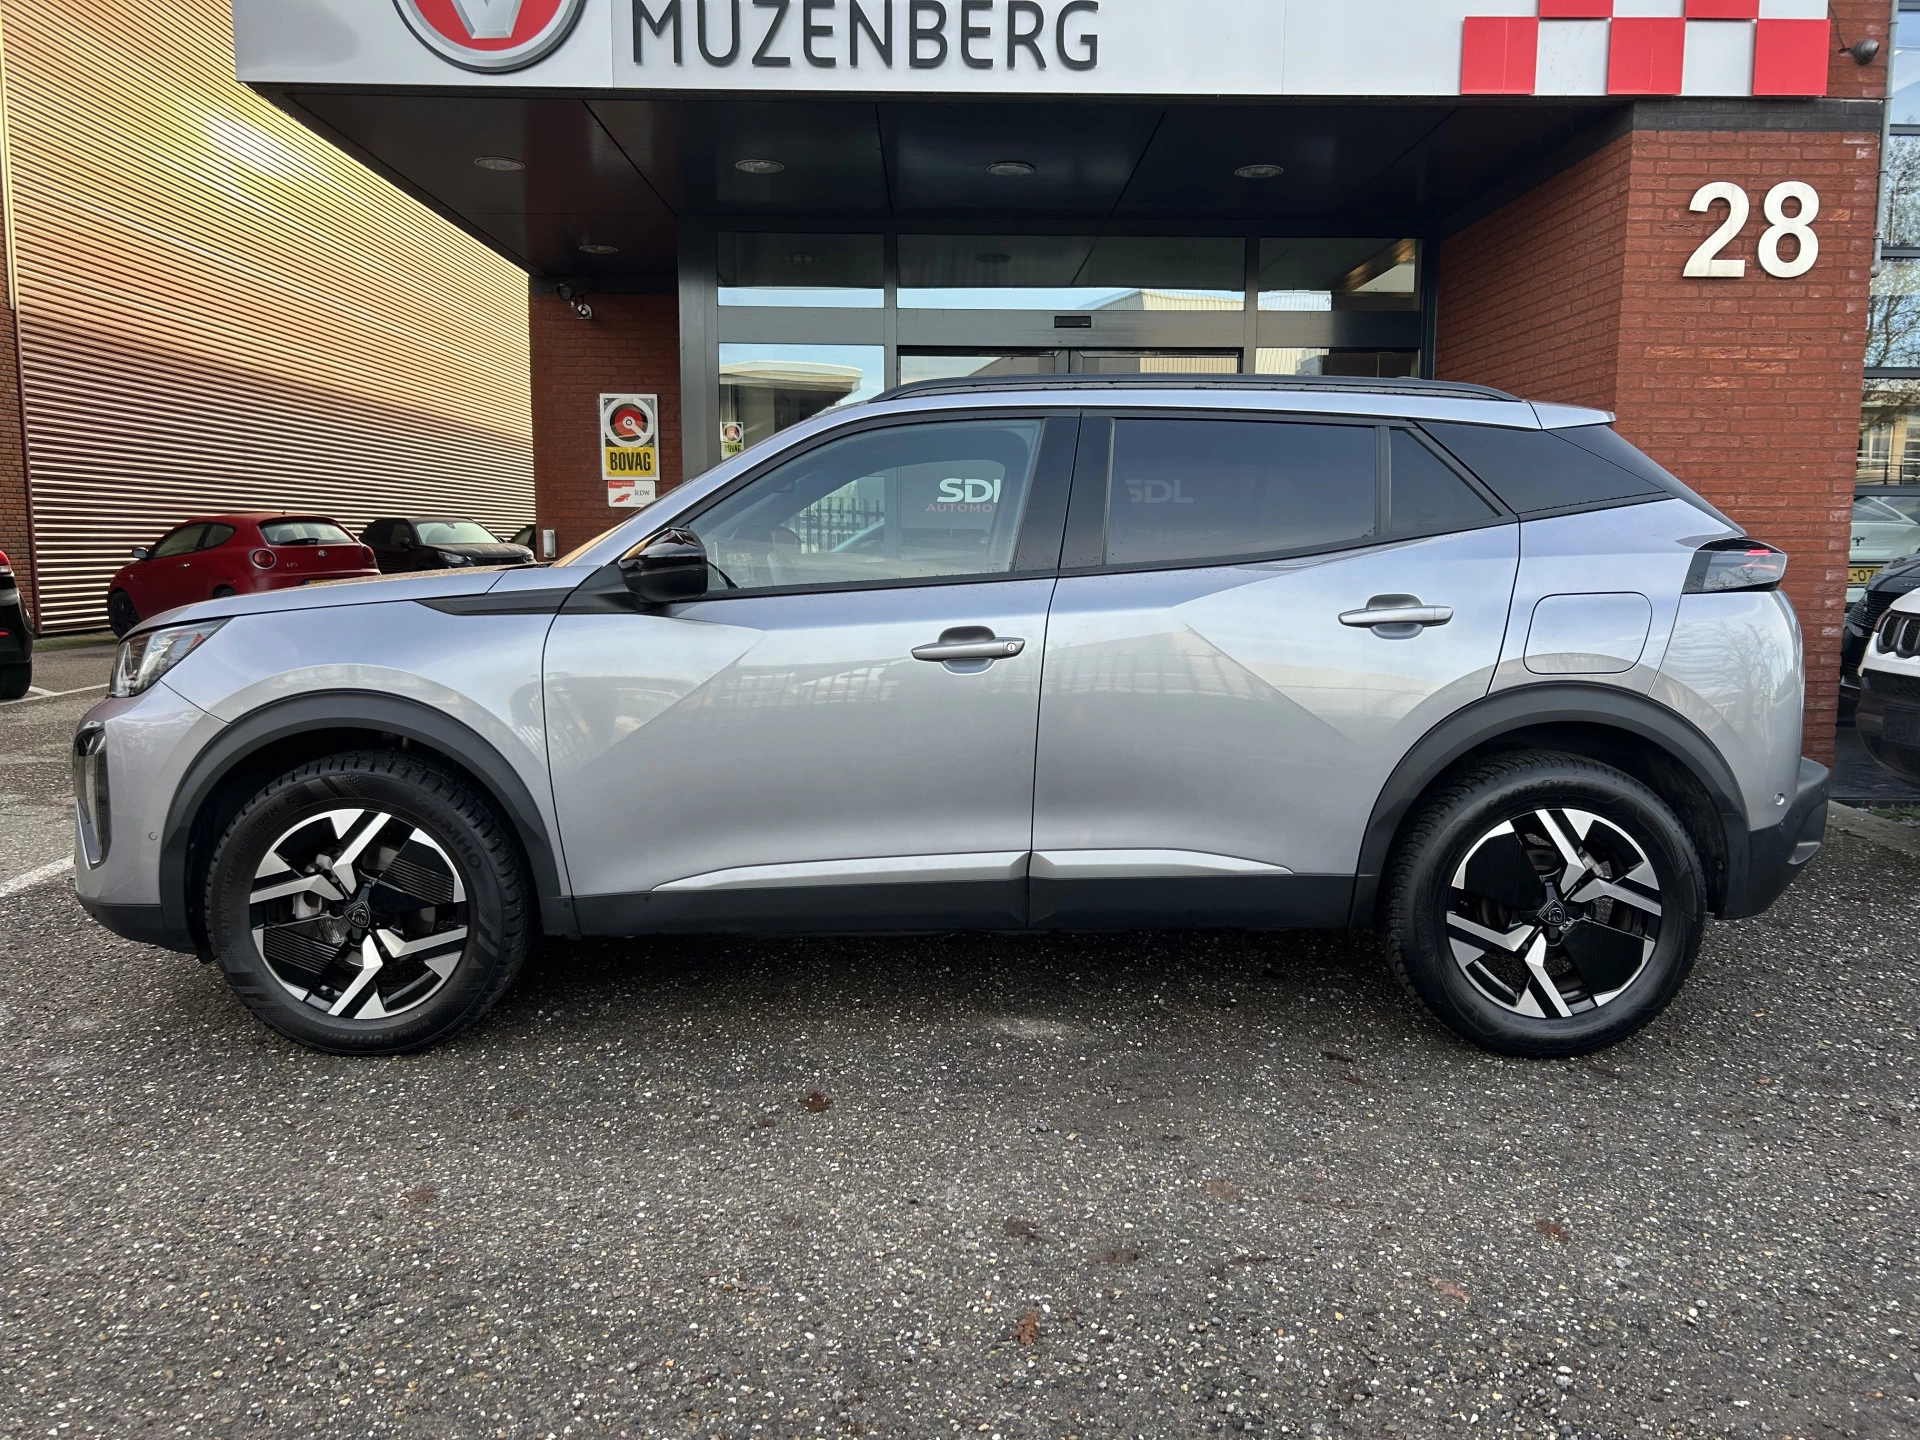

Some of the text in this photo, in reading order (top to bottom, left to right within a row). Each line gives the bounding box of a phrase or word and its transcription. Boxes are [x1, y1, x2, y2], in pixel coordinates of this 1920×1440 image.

[632, 0, 1098, 71] MUZENBERG
[1683, 181, 1819, 278] 28
[609, 451, 651, 471] BOVAG
[926, 503, 994, 513] AUTOMO
